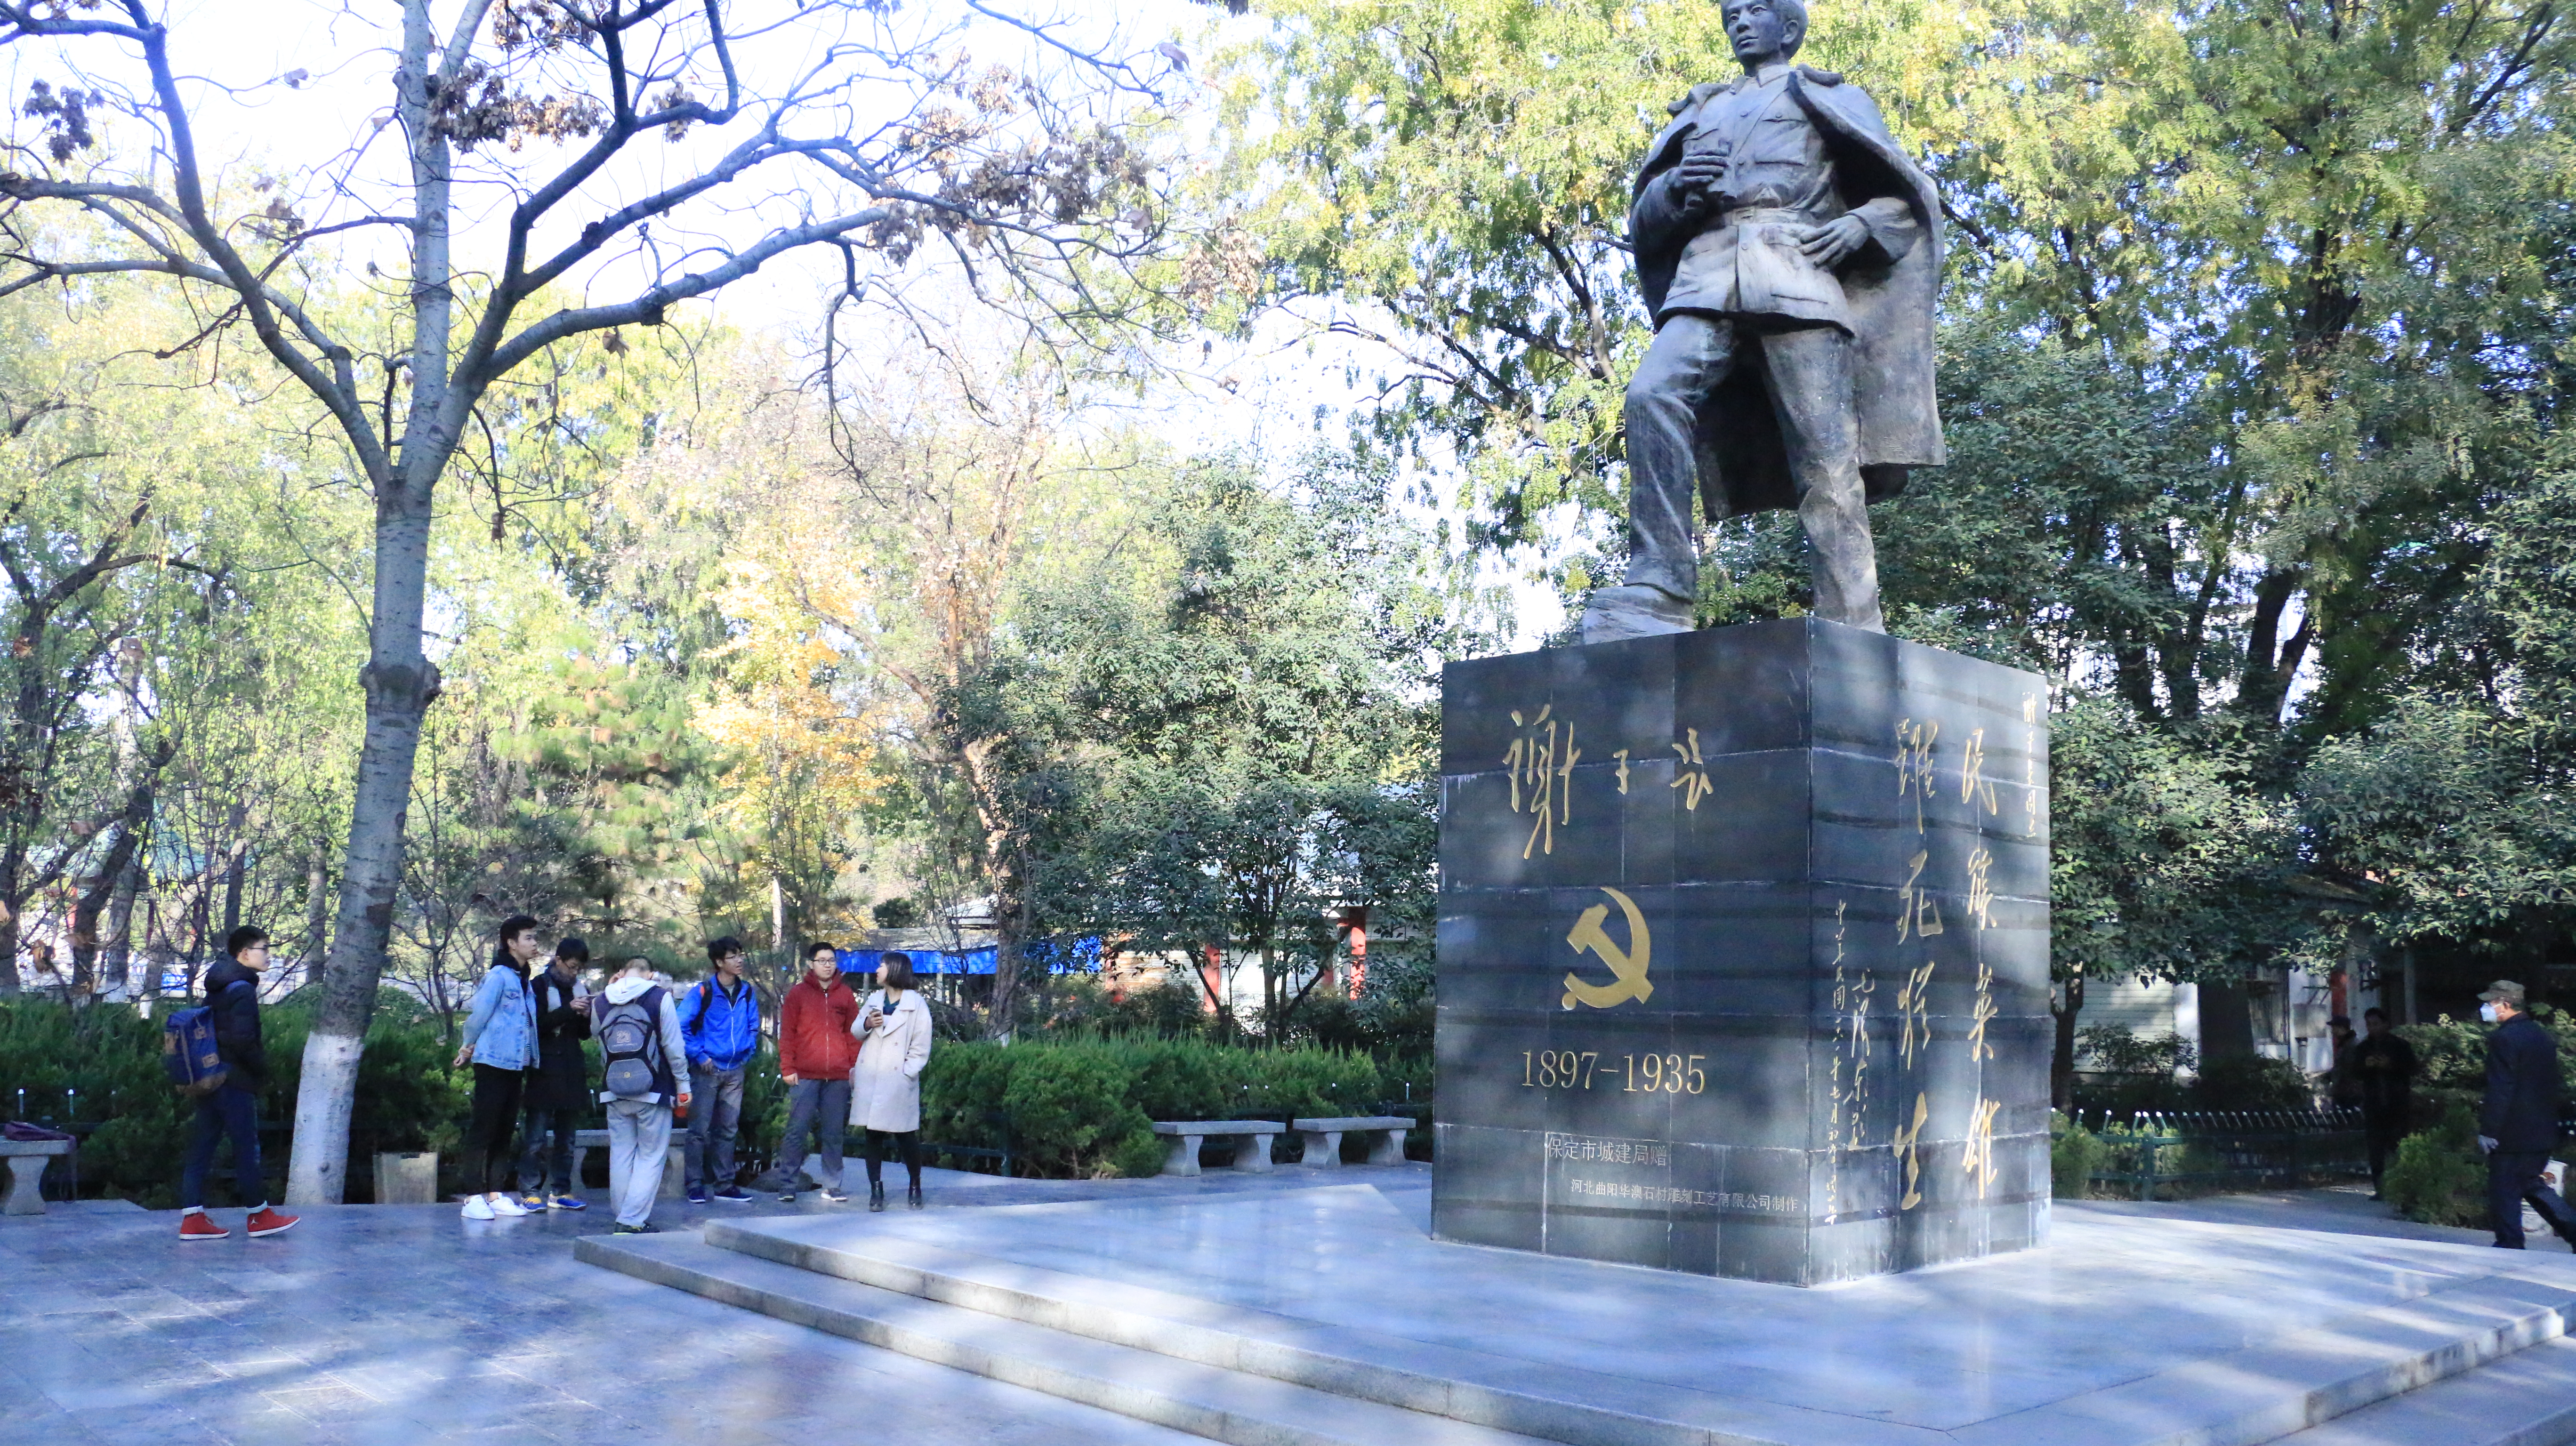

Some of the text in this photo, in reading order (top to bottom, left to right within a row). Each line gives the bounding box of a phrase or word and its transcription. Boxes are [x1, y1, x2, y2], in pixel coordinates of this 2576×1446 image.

[1522, 1049, 1705, 1094] 1897-1935
[1546, 1137, 1667, 1166] 保定市城建局赠
